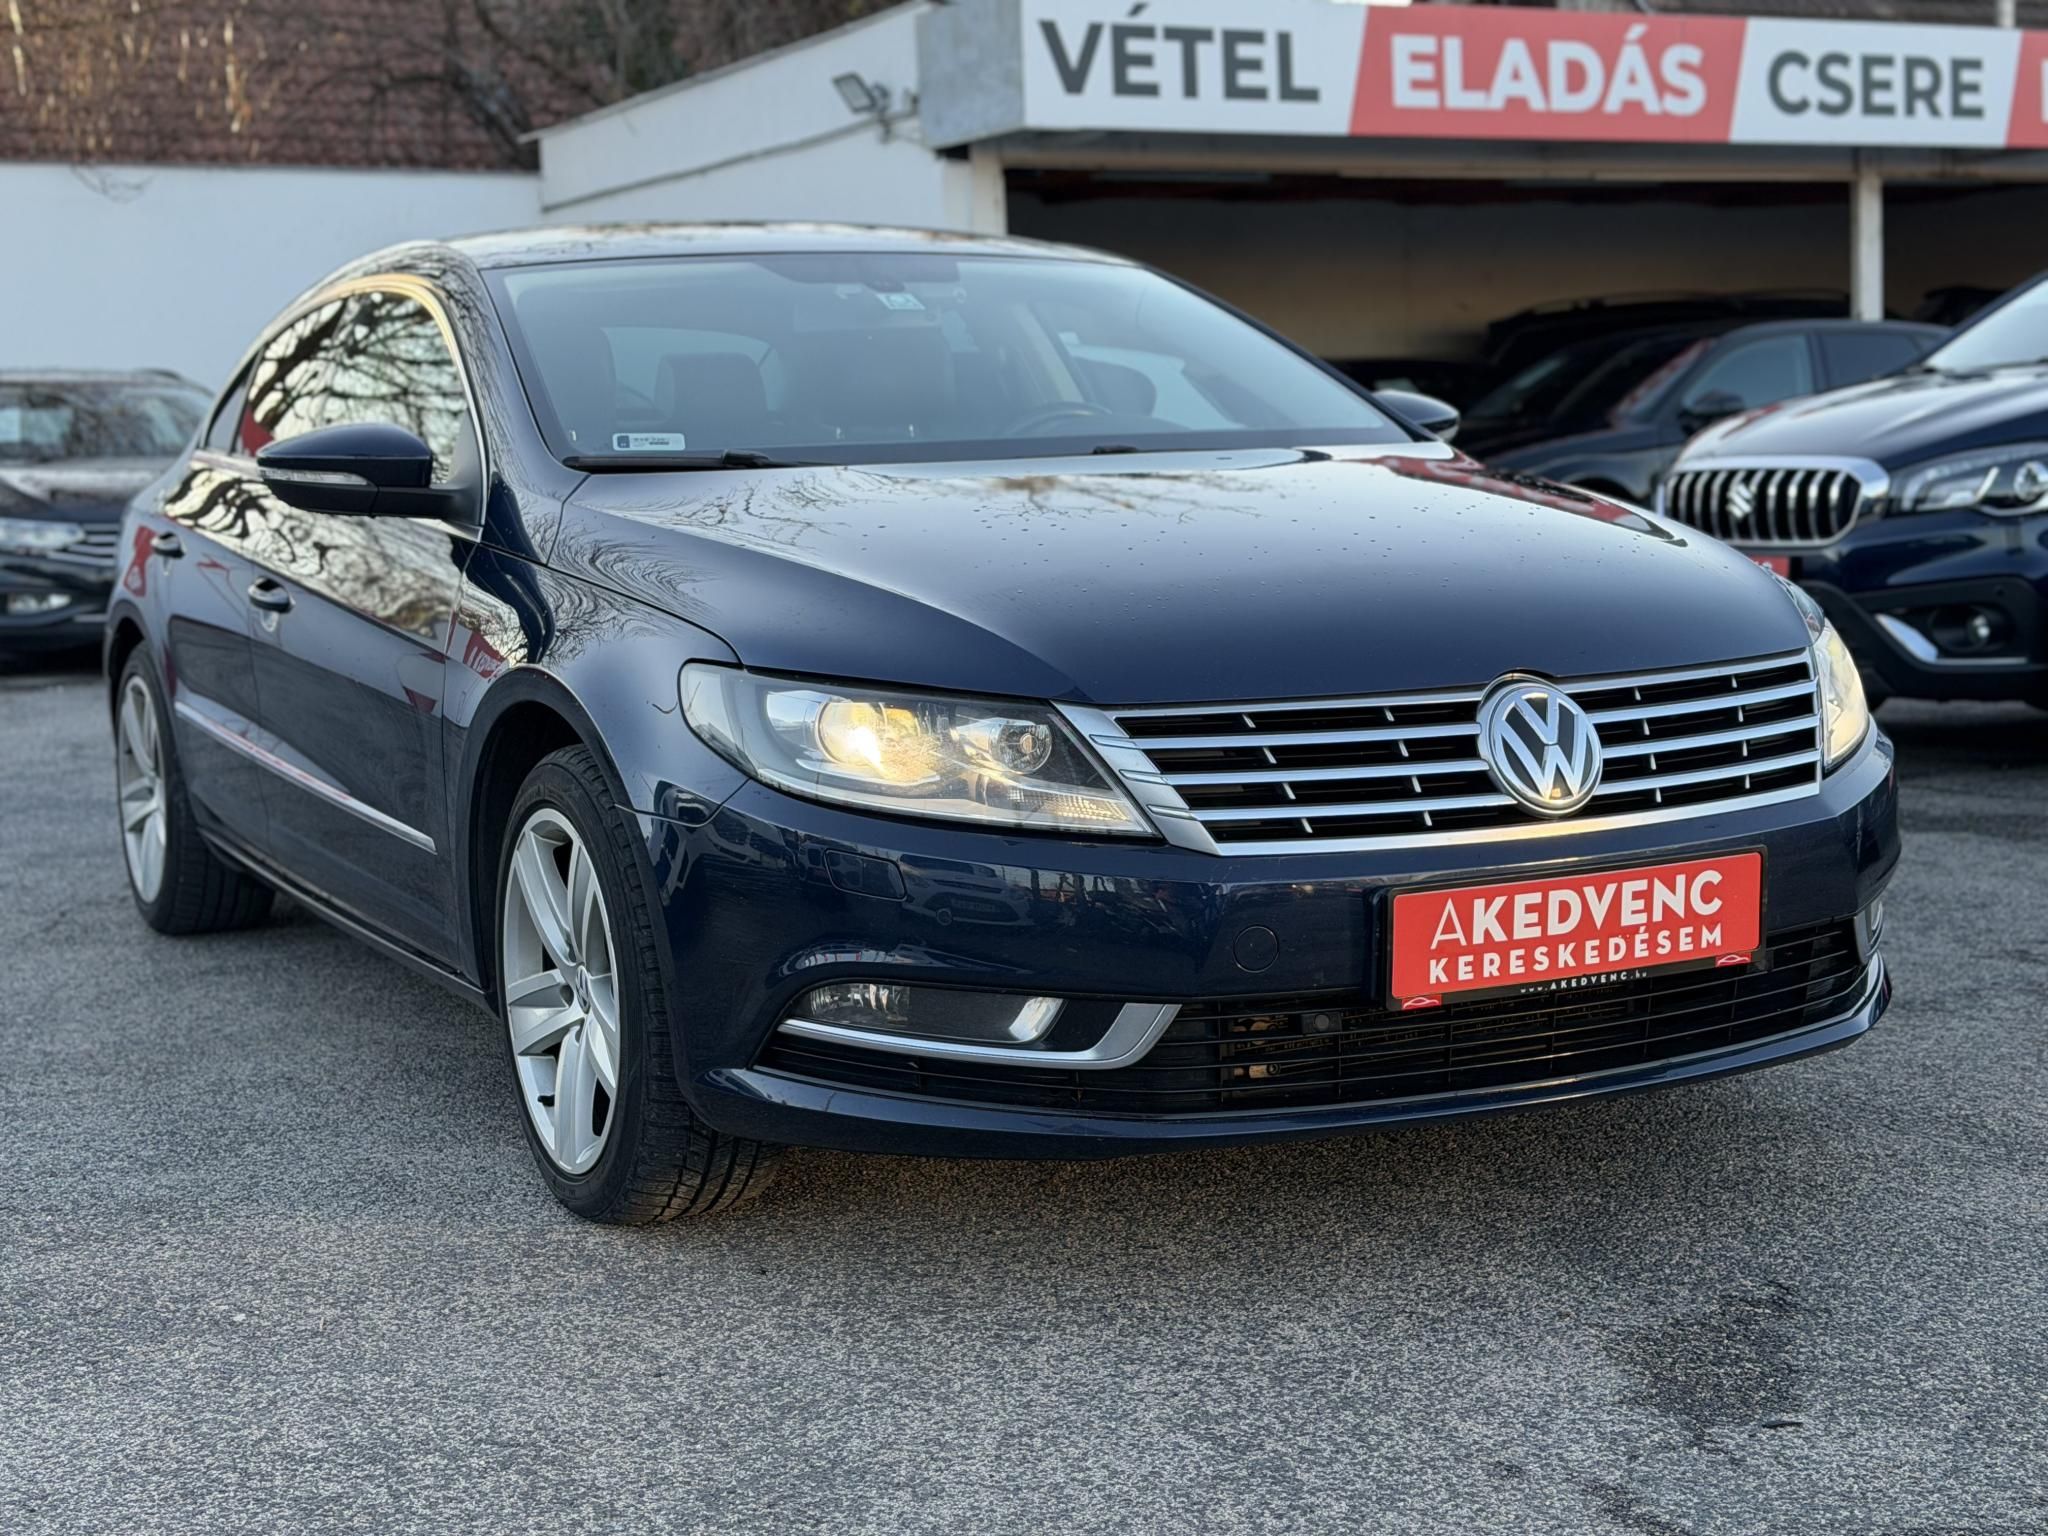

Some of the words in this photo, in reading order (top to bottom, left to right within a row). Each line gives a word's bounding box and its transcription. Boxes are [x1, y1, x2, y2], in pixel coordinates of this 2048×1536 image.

[1038, 2, 1320, 102] VÉTEL
[1391, 24, 1707, 115] ELADÁS
[1768, 50, 1985, 118] CSERE
[1429, 922, 1722, 985] KERESKEDÉSEM
